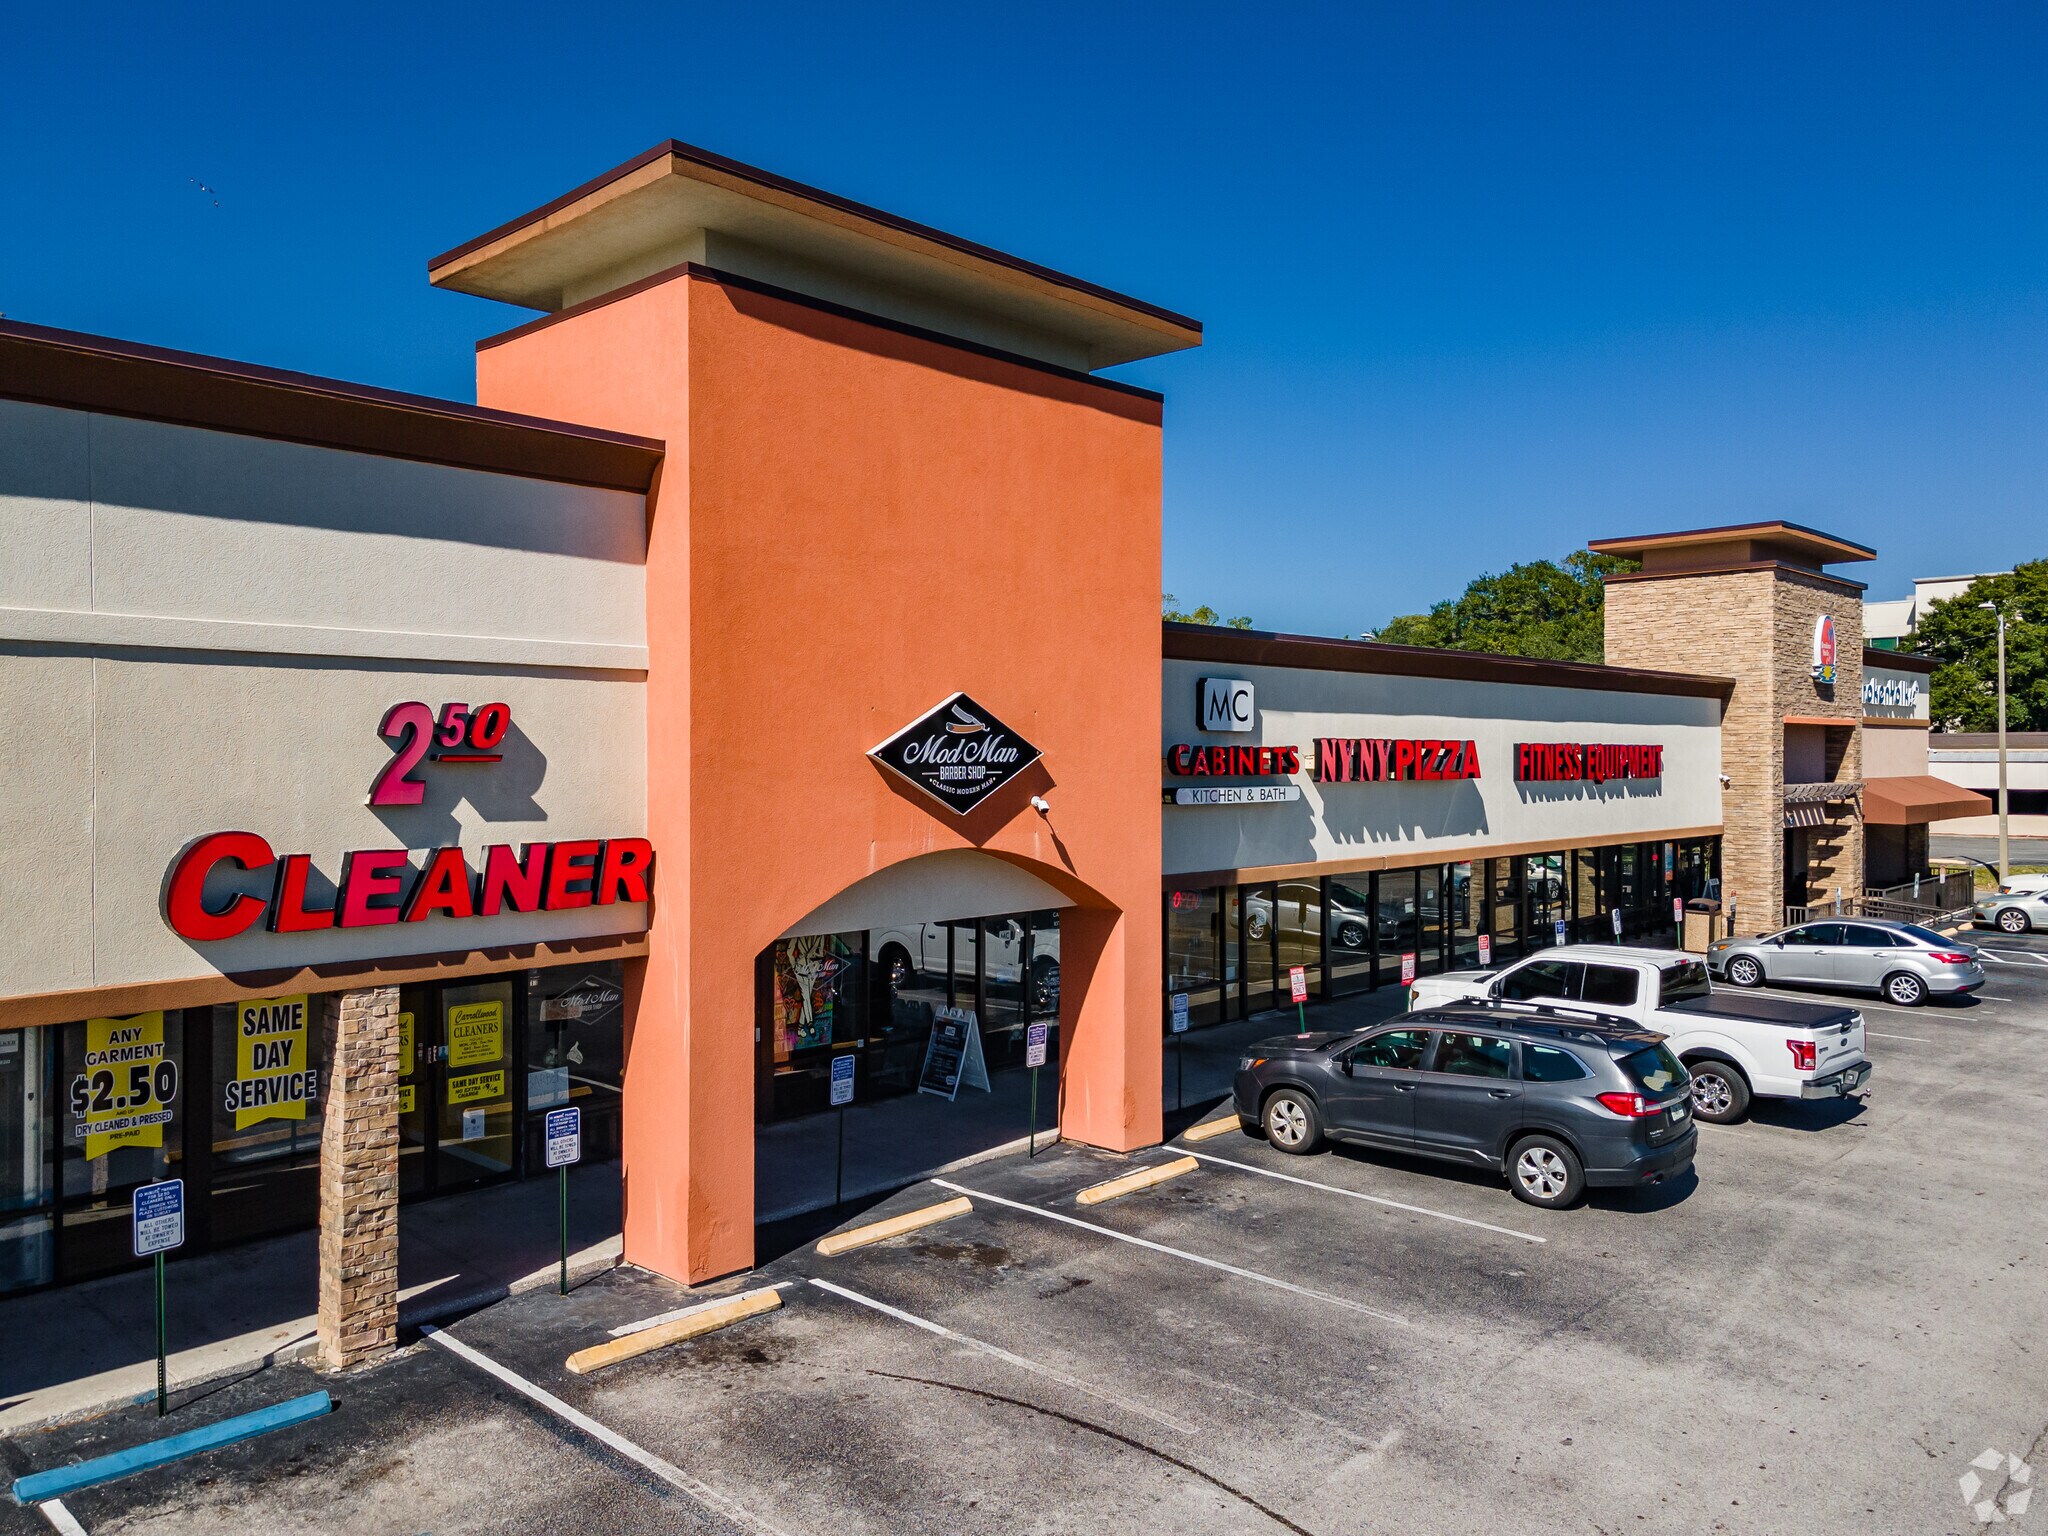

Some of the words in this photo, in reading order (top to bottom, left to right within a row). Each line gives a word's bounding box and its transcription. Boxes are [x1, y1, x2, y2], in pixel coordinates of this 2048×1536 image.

[1209, 688, 1248, 722] MC
[903, 734, 966, 764] Mod
[963, 734, 1019, 763] Man
[1169, 744, 1300, 776] CABINETS
[1395, 739, 1482, 781] PIZZA
[1517, 743, 1582, 781] FITNESS
[1587, 743, 1664, 784] EQUIPMENT
[940, 766, 967, 780] BARBER
[968, 765, 986, 780] SHOP
[932, 779, 956, 794] CLASSIC
[956, 786, 981, 795] MODERN
[981, 778, 994, 790] MAN
[1192, 789, 1242, 803] KITCHEN
[1246, 788, 1254, 801] &
[1260, 788, 1286, 800] BATH
[162, 831, 655, 940] CLEANER
[817, 959, 839, 972] Man
[591, 990, 620, 1004] Man
[242, 1002, 304, 1038] SAME
[455, 1006, 498, 1024] Carrollwood
[108, 1027, 142, 1045] ANY
[454, 1022, 498, 1038] CLEANERS
[86, 1042, 164, 1066] GARMENT
[252, 1038, 294, 1072] DAY
[71, 1060, 178, 1118] $2.50
[452, 1080, 467, 1088] SAME
[480, 1074, 501, 1084] SERVICE
[225, 1070, 316, 1112] SERVICE
[76, 1124, 93, 1136] DRY
[94, 1118, 130, 1133] CLEANED
[131, 1116, 137, 1126] &
[139, 1110, 172, 1125] PRESSED
[110, 1129, 140, 1140] PRE-PAID
[155, 1217, 174, 1226] OTHERS
[162, 1222, 178, 1231] TOWED
[148, 1237, 171, 1247] EXPENSE
